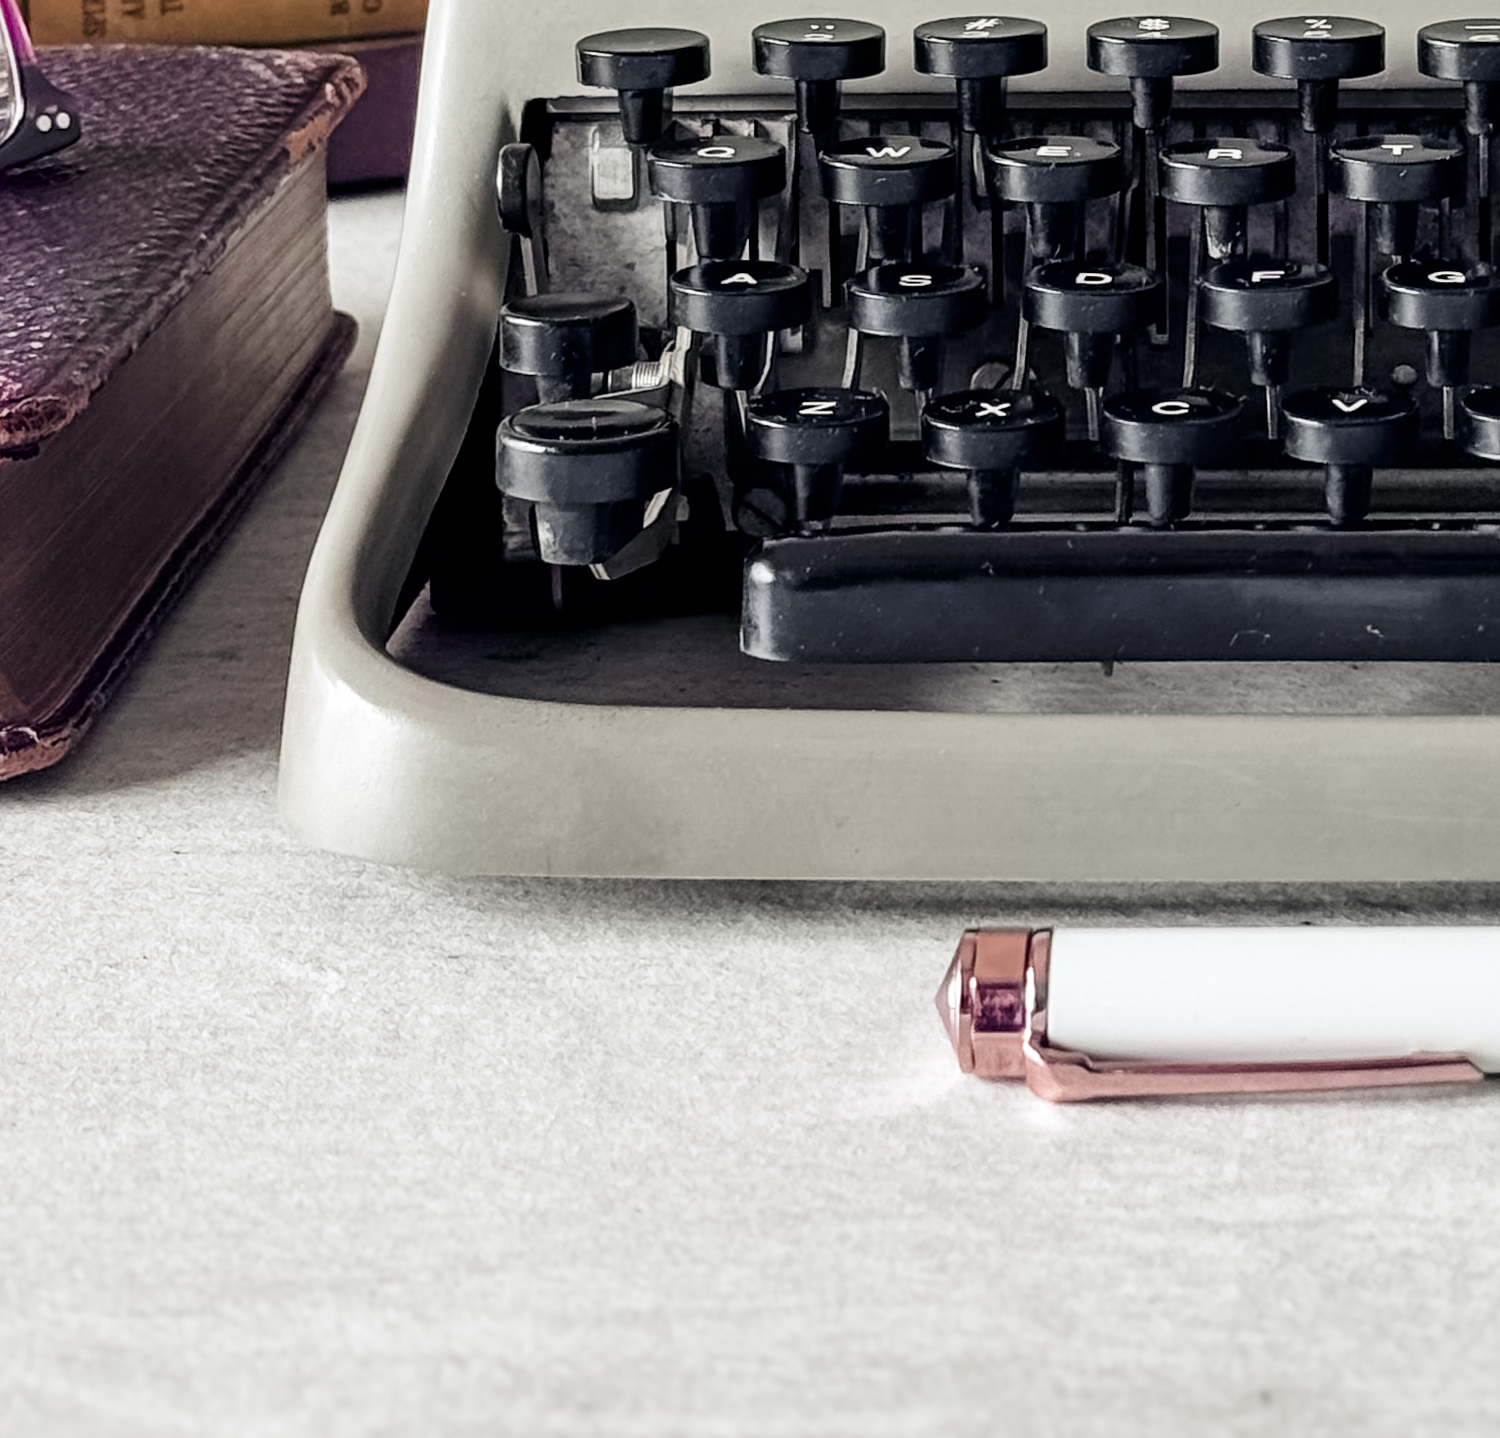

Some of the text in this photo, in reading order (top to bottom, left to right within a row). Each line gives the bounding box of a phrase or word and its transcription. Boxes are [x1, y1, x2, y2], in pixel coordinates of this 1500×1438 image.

[697, 146, 736, 159] Q
[866, 146, 911, 159] W
[1036, 145, 1072, 157] E
[1207, 148, 1243, 160] R
[1381, 144, 1414, 156] T
[720, 272, 758, 285] A
[898, 274, 932, 287] S
[1075, 272, 1113, 285] D
[1251, 270, 1285, 283] F
[1427, 270, 1466, 283] G
[798, 401, 837, 415] Z
[975, 402, 1011, 417] X
[1151, 401, 1190, 415] C
[1332, 398, 1368, 412] V
